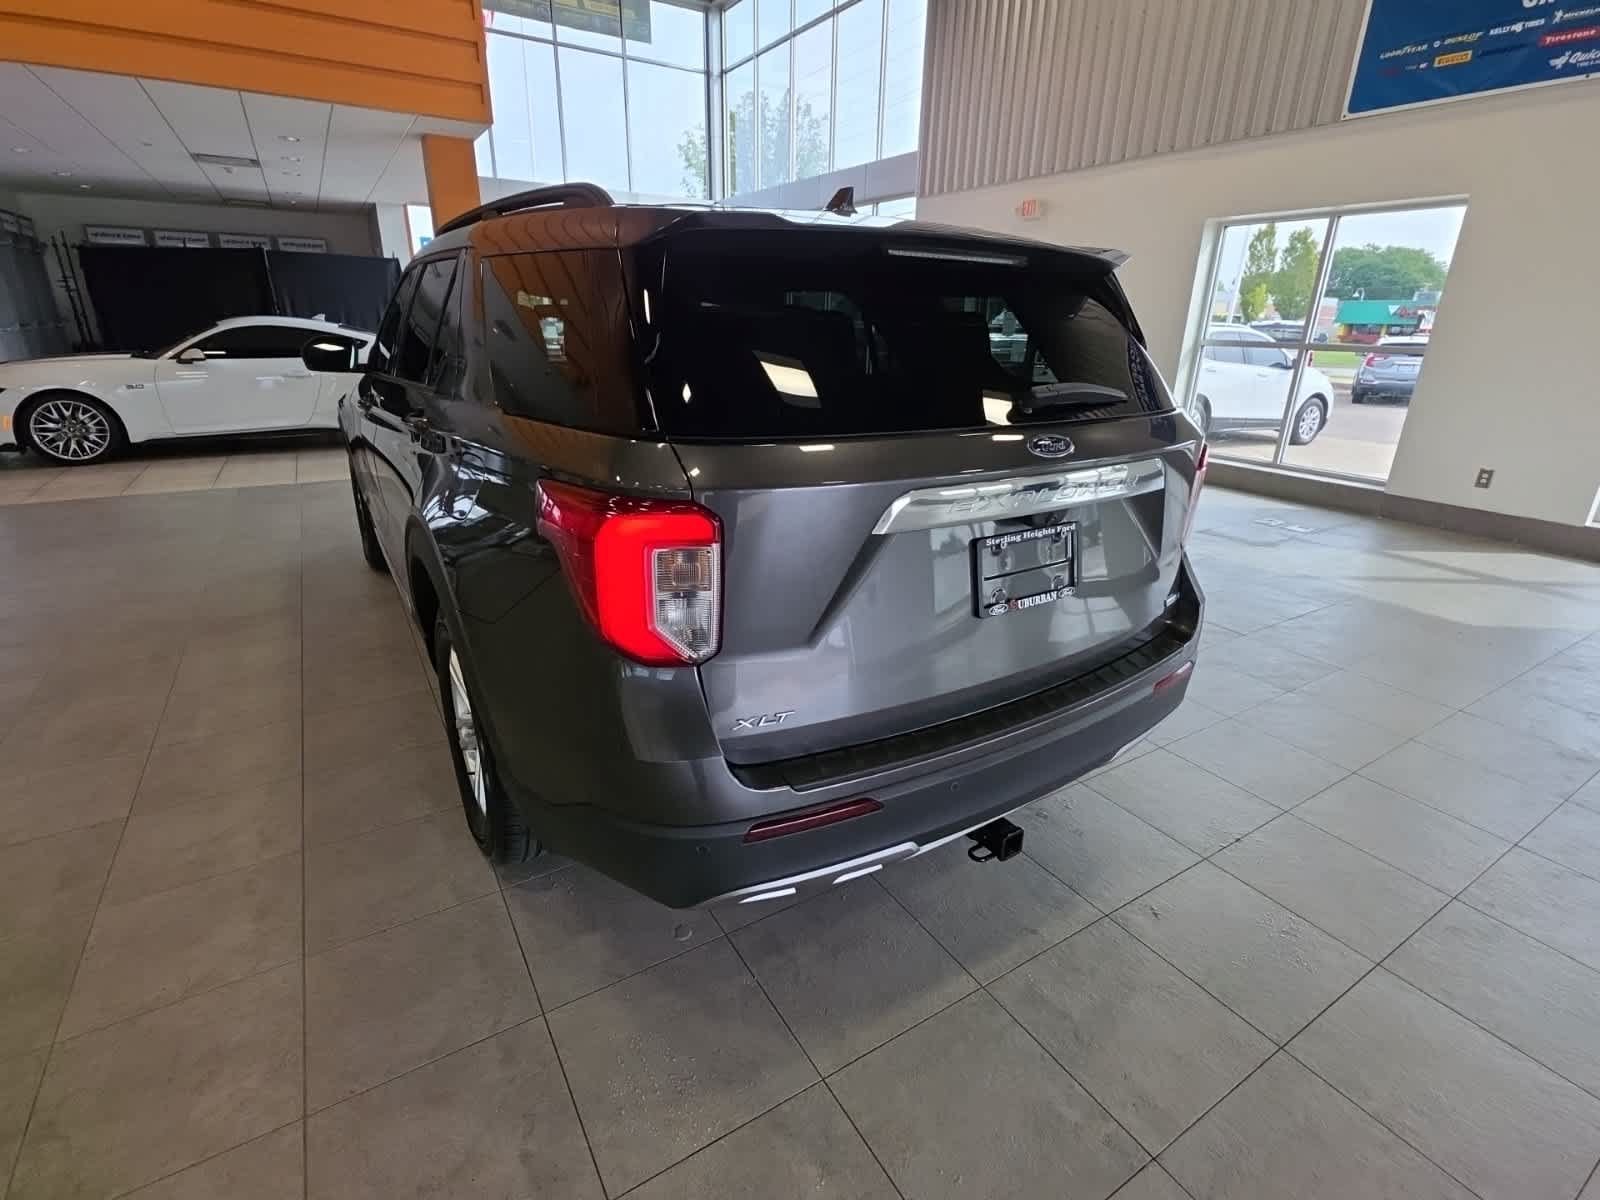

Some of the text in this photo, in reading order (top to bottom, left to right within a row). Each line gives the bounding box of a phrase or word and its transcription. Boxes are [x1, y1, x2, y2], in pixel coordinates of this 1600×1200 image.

[1569, 49, 1600, 64] Quic
[1033, 438, 1068, 453] Ford
[948, 475, 1139, 513] EXPLORER
[986, 523, 1076, 549] Sterling Heights Ford
[1009, 591, 1058, 610] SUBURBAN
[730, 710, 796, 732] XLT
